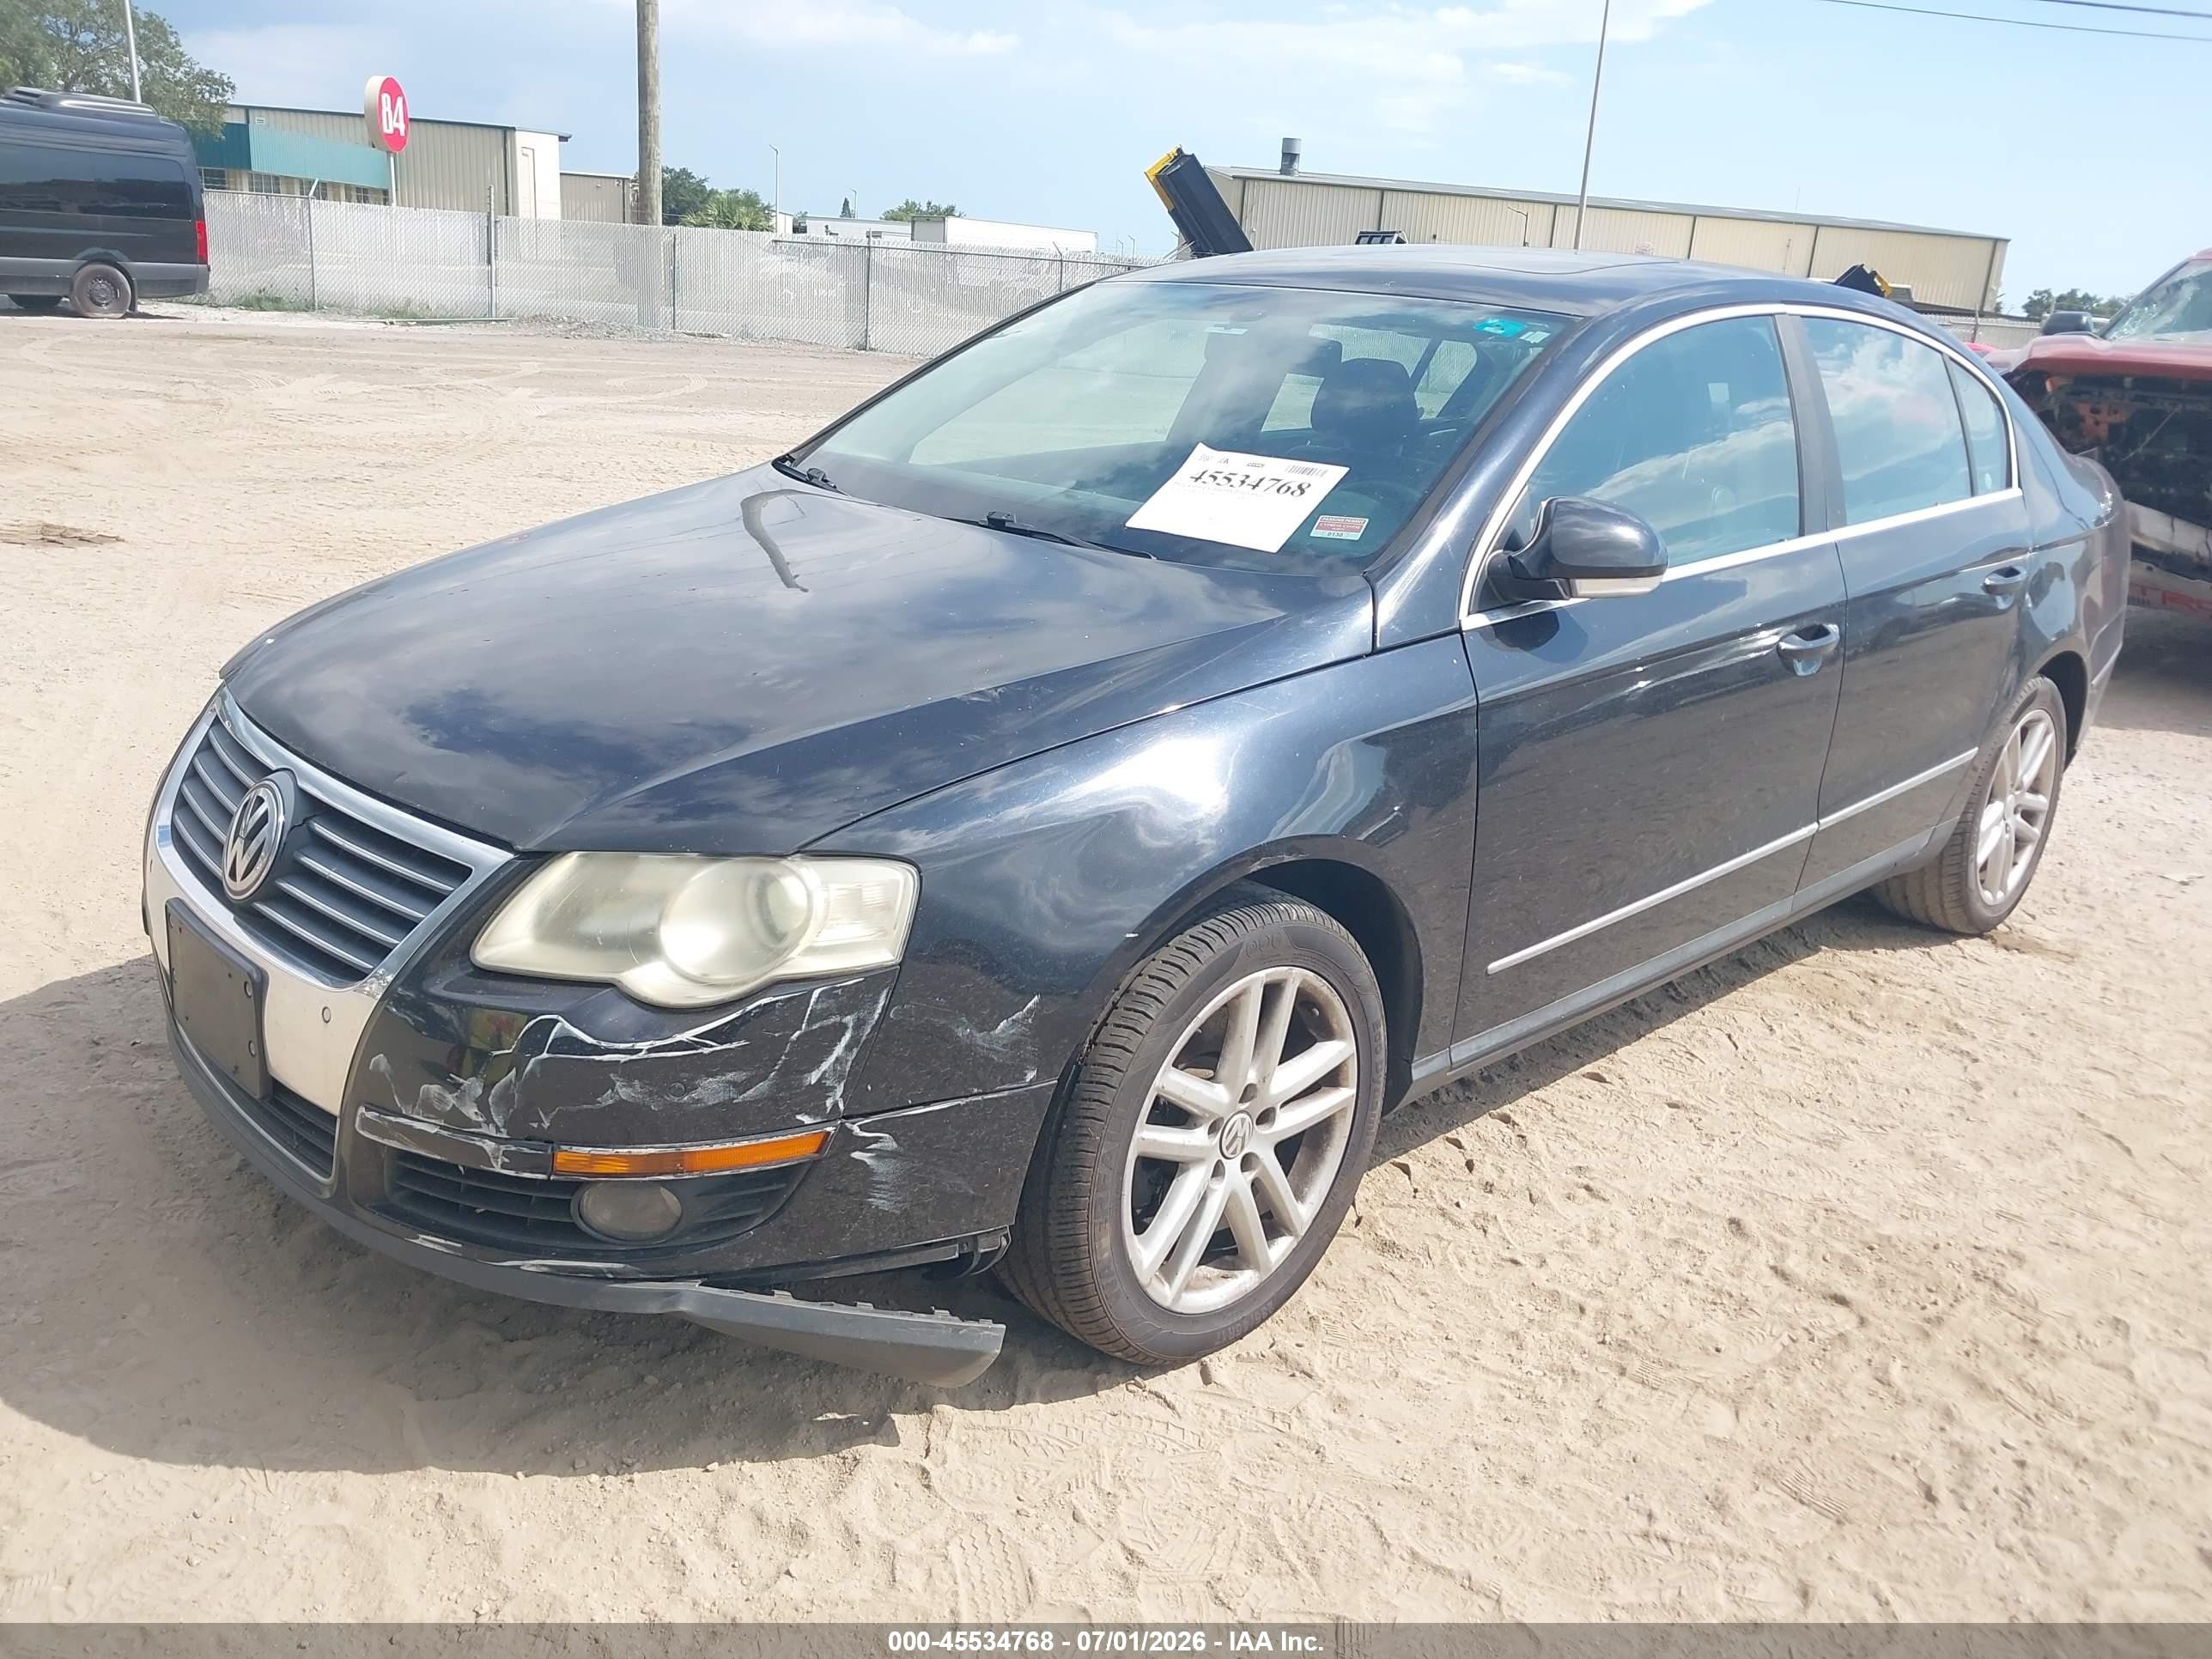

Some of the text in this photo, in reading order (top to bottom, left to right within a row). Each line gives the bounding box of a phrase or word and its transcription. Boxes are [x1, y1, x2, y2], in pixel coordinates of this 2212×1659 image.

[381, 92, 405, 137] 84
[1189, 470, 1311, 497] 45534768
[225, 785, 277, 893] VW
[1222, 1113, 1252, 1157] VW
